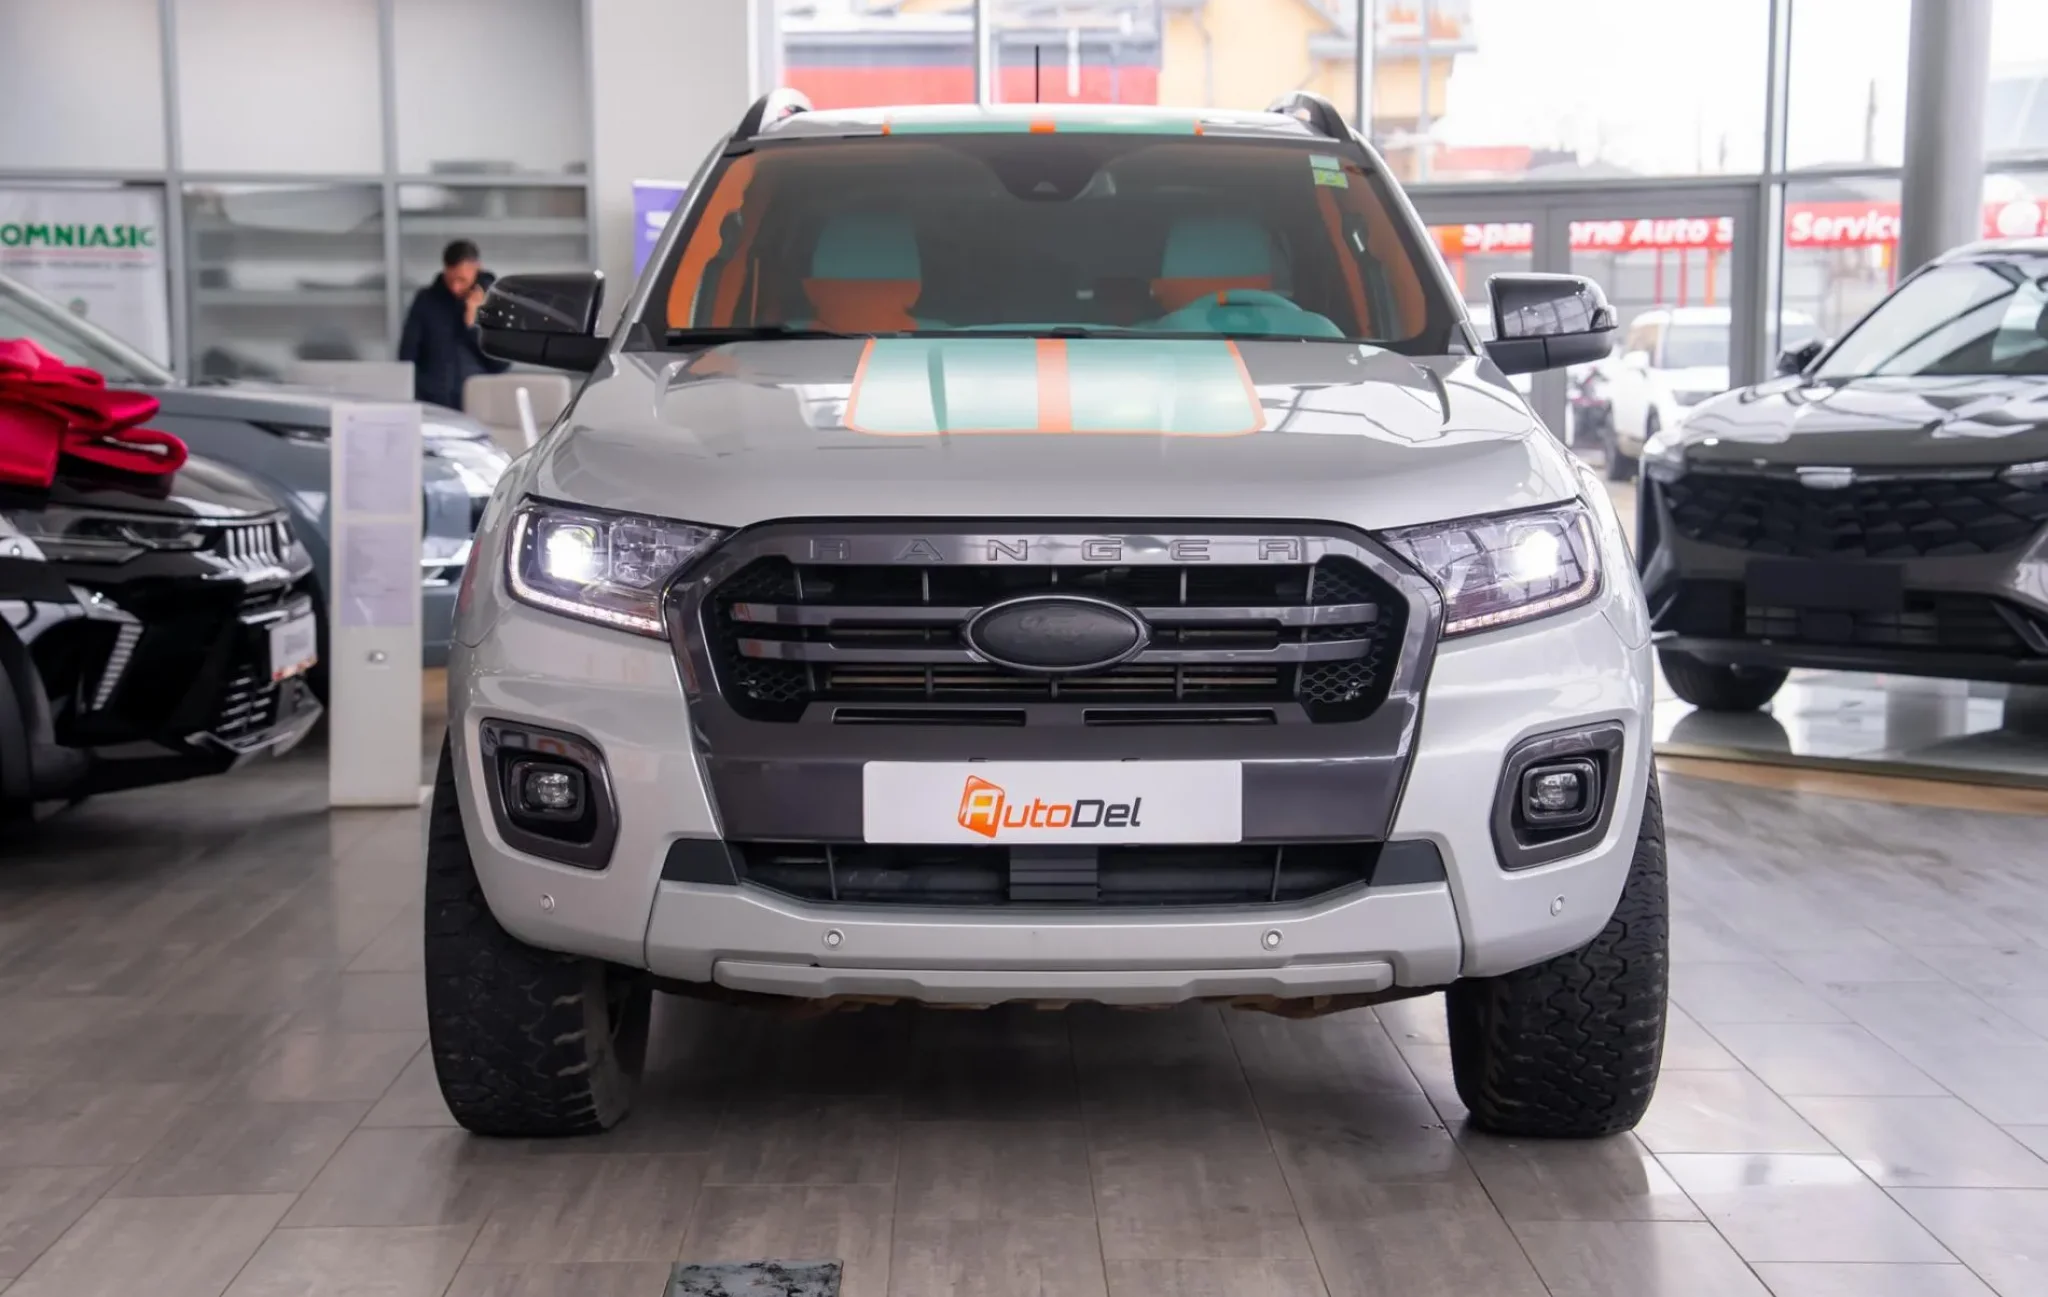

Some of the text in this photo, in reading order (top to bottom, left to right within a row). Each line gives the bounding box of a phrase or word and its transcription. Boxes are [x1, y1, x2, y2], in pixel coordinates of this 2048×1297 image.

[1629, 217, 1709, 245] Auto
[809, 538, 1300, 562] RANGER
[960, 784, 1142, 830] AutoDel
